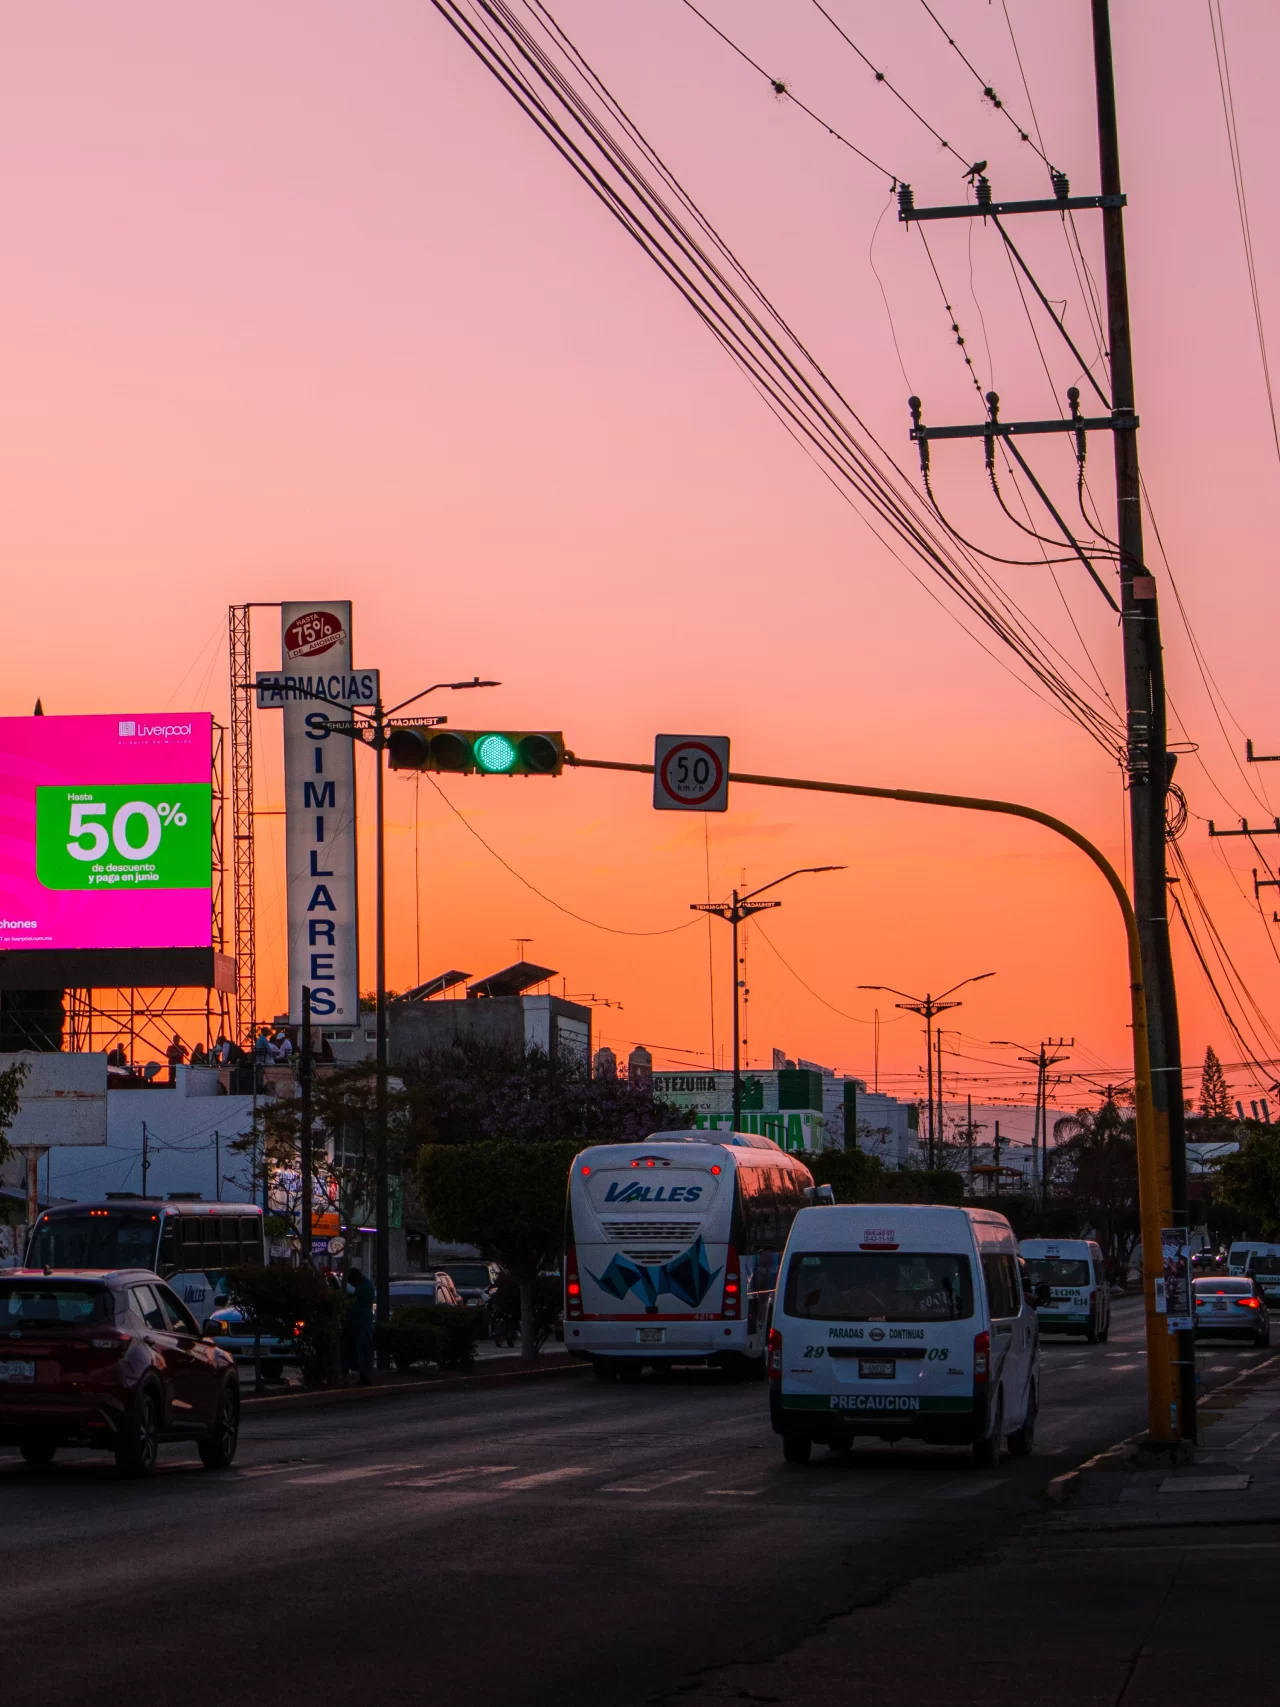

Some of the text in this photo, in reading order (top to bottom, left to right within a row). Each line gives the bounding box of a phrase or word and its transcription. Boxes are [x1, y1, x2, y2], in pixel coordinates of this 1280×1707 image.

[296, 614, 319, 626] HASTA
[292, 618, 332, 646] 75%
[293, 633, 341, 656] DE AHORRO
[261, 675, 374, 701] FARMACIAS
[137, 723, 192, 739] Liverpool
[321, 721, 369, 729] EHUAÁN
[677, 756, 709, 784] 50
[67, 793, 93, 801] Hasta
[66, 800, 188, 862] 50%
[92, 863, 156, 872] de descuento
[88, 872, 160, 884] y paga en junio
[654, 1076, 717, 1092] CTEZUMA
[604, 1181, 703, 1203] VALLES
[1054, 1288, 1081, 1297] UCION
[829, 1327, 864, 1339] PARADAS
[889, 1329, 925, 1340] CONTINUAS
[803, 1345, 825, 1358] 29
[927, 1347, 949, 1361] 08
[829, 1395, 920, 1411] PRECAUCION
